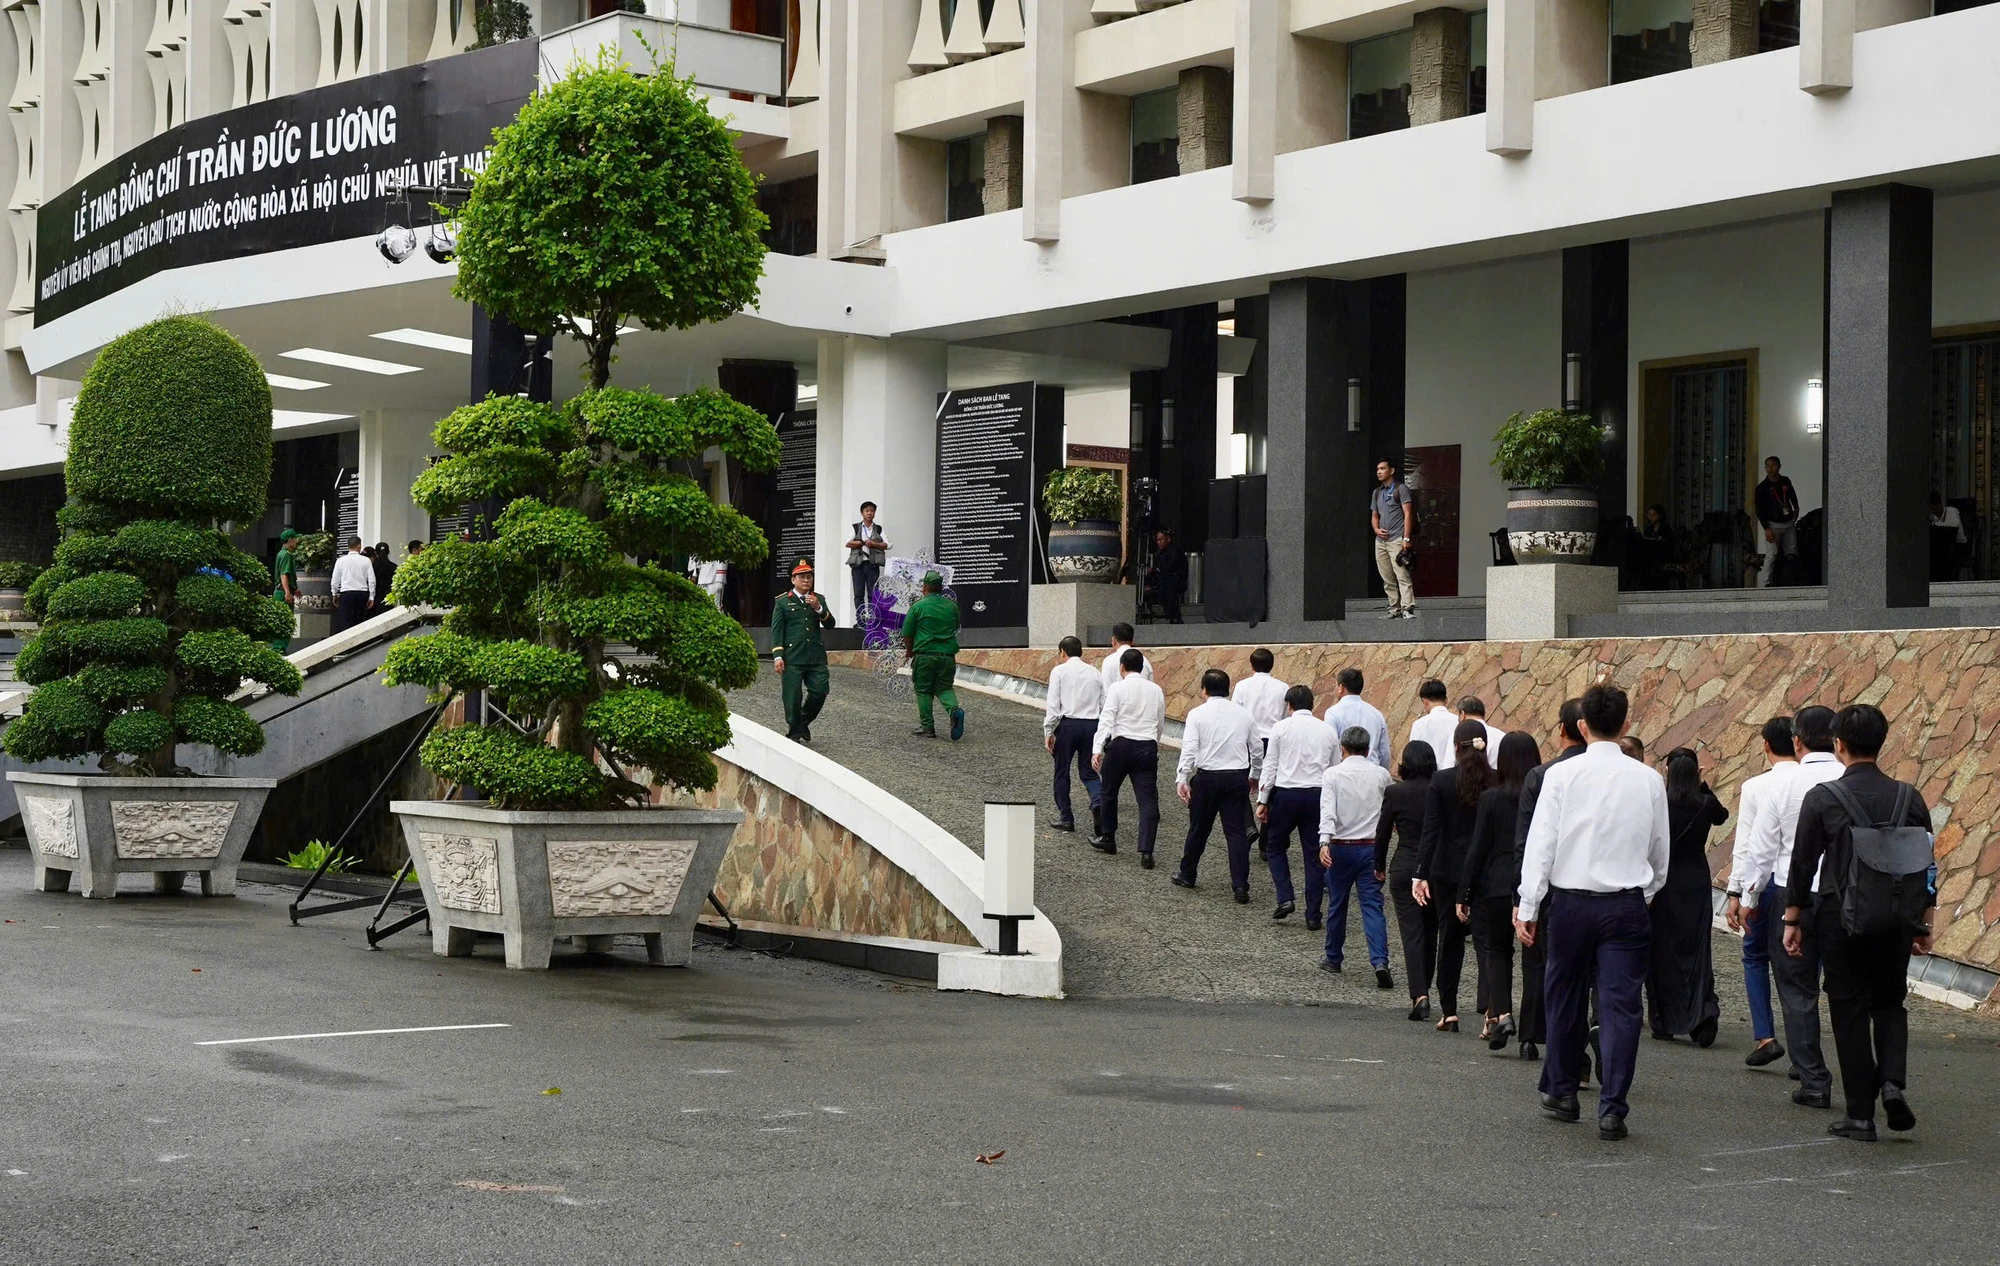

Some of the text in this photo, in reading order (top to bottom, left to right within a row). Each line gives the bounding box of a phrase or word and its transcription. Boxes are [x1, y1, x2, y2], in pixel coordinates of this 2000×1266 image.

[41, 267, 61, 301] NGUYÊN
[69, 255, 82, 286] VIÊN
[82, 248, 91, 281] BỘ
[92, 242, 110, 275] CHÍNH
[110, 239, 122, 268] TRỊ,
[123, 221, 148, 259] NGUYÊN
[149, 209, 165, 247] CHỦ
[165, 210, 186, 244] TỊCH
[188, 198, 221, 233] NƯỚC
[224, 192, 257, 230] CỘNG
[260, 184, 287, 219] HÒA
[290, 178, 309, 213] XÃ
[313, 173, 338, 212] HỘI
[341, 163, 370, 204] CHỦ
[375, 158, 419, 198] NGHĨA
[74, 104, 397, 242] LỄ TANG ĐỒNG CHÍ TRẦN ĐỨC LƯƠNG
